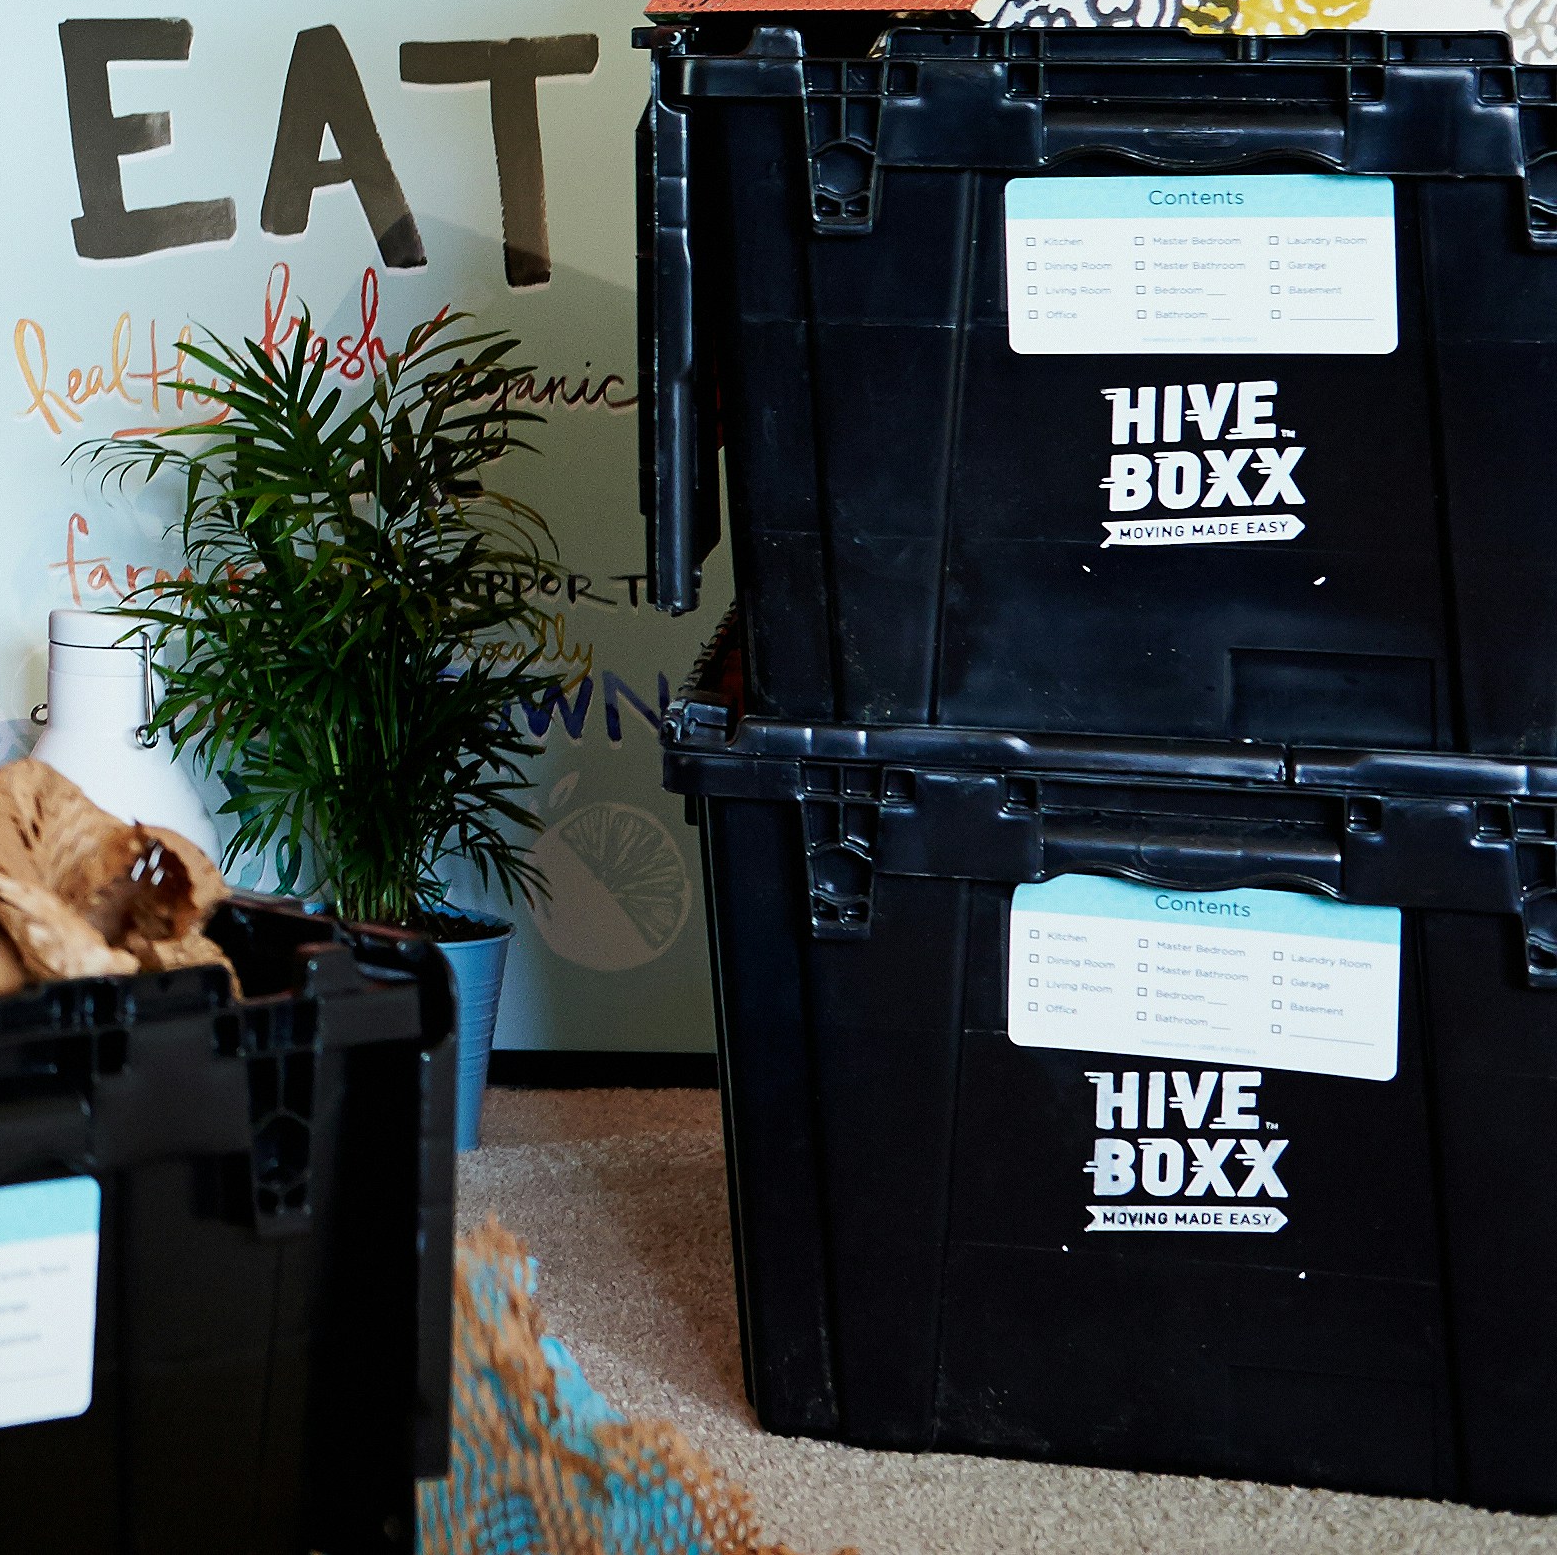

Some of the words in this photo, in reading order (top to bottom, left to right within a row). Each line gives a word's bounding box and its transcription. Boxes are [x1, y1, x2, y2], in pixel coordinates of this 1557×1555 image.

[57, 17, 600, 287] EAT
[1148, 189, 1245, 206] Contents
[1044, 237, 1083, 246] Kitchen
[1152, 237, 1187, 245] Master
[1192, 236, 1242, 245] Bedroom
[1287, 236, 1331, 248] Laundry
[1334, 237, 1367, 245] Room
[1044, 262, 1078, 272] Dining
[1082, 262, 1113, 270] Room
[1153, 261, 1188, 270] Master
[1194, 261, 1245, 270] Bathroom
[1288, 261, 1327, 272] Garage
[1045, 286, 1078, 296] Living
[1081, 286, 1111, 295] Room
[1154, 286, 1204, 295] Bedroom
[1288, 286, 1341, 295] Basement
[1046, 310, 1077, 319] Office
[1155, 310, 1208, 319] Bathroom
[1100, 380, 1277, 445] HIVE
[1098, 446, 1306, 512] BOXX
[1119, 525, 1185, 539] MOVING
[1192, 523, 1239, 536] MADE
[1246, 521, 1289, 534] EASY
[1155, 894, 1252, 918] Contents
[1047, 932, 1088, 943] Kitchen
[1157, 941, 1192, 954] Master
[1195, 945, 1246, 957] Bedroom
[1046, 956, 1081, 970] Dining
[1084, 959, 1116, 969] Room
[1291, 953, 1335, 969] Laundry
[1339, 958, 1372, 969] Room
[1156, 965, 1192, 978] Master
[1195, 969, 1249, 981] Bathroom
[1046, 980, 1078, 993] Living
[1081, 983, 1113, 994] Room
[1290, 978, 1330, 990] Garage
[1155, 990, 1205, 1002] Bedroom
[1046, 1005, 1077, 1015] Office
[1290, 1002, 1344, 1016] Basement
[1155, 1014, 1209, 1026] Bathroom
[1084, 1071, 1262, 1130] HIVE
[1083, 1138, 1289, 1197] BOXX
[1103, 1212, 1168, 1226] MOVING
[1174, 1212, 1223, 1225] MADE
[1230, 1213, 1272, 1225] EASY
